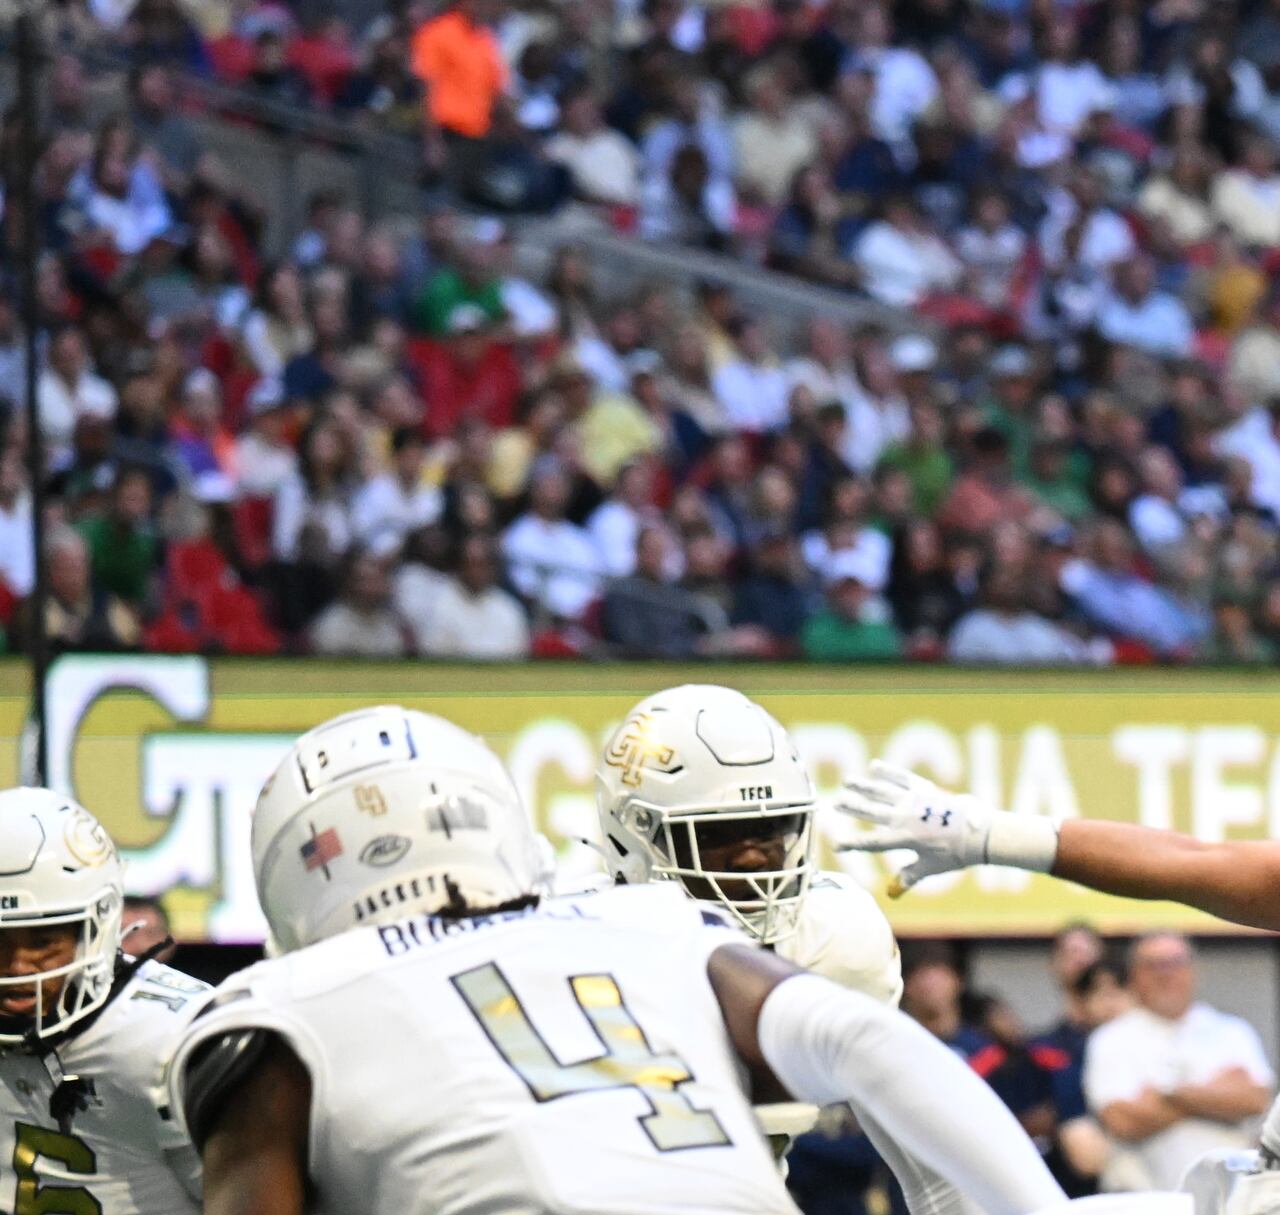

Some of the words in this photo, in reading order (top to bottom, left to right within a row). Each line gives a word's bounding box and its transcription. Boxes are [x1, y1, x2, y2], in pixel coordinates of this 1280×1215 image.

[739, 785, 773, 801] TECH
[0, 896, 19, 909] CH
[448, 960, 736, 1152] 4
